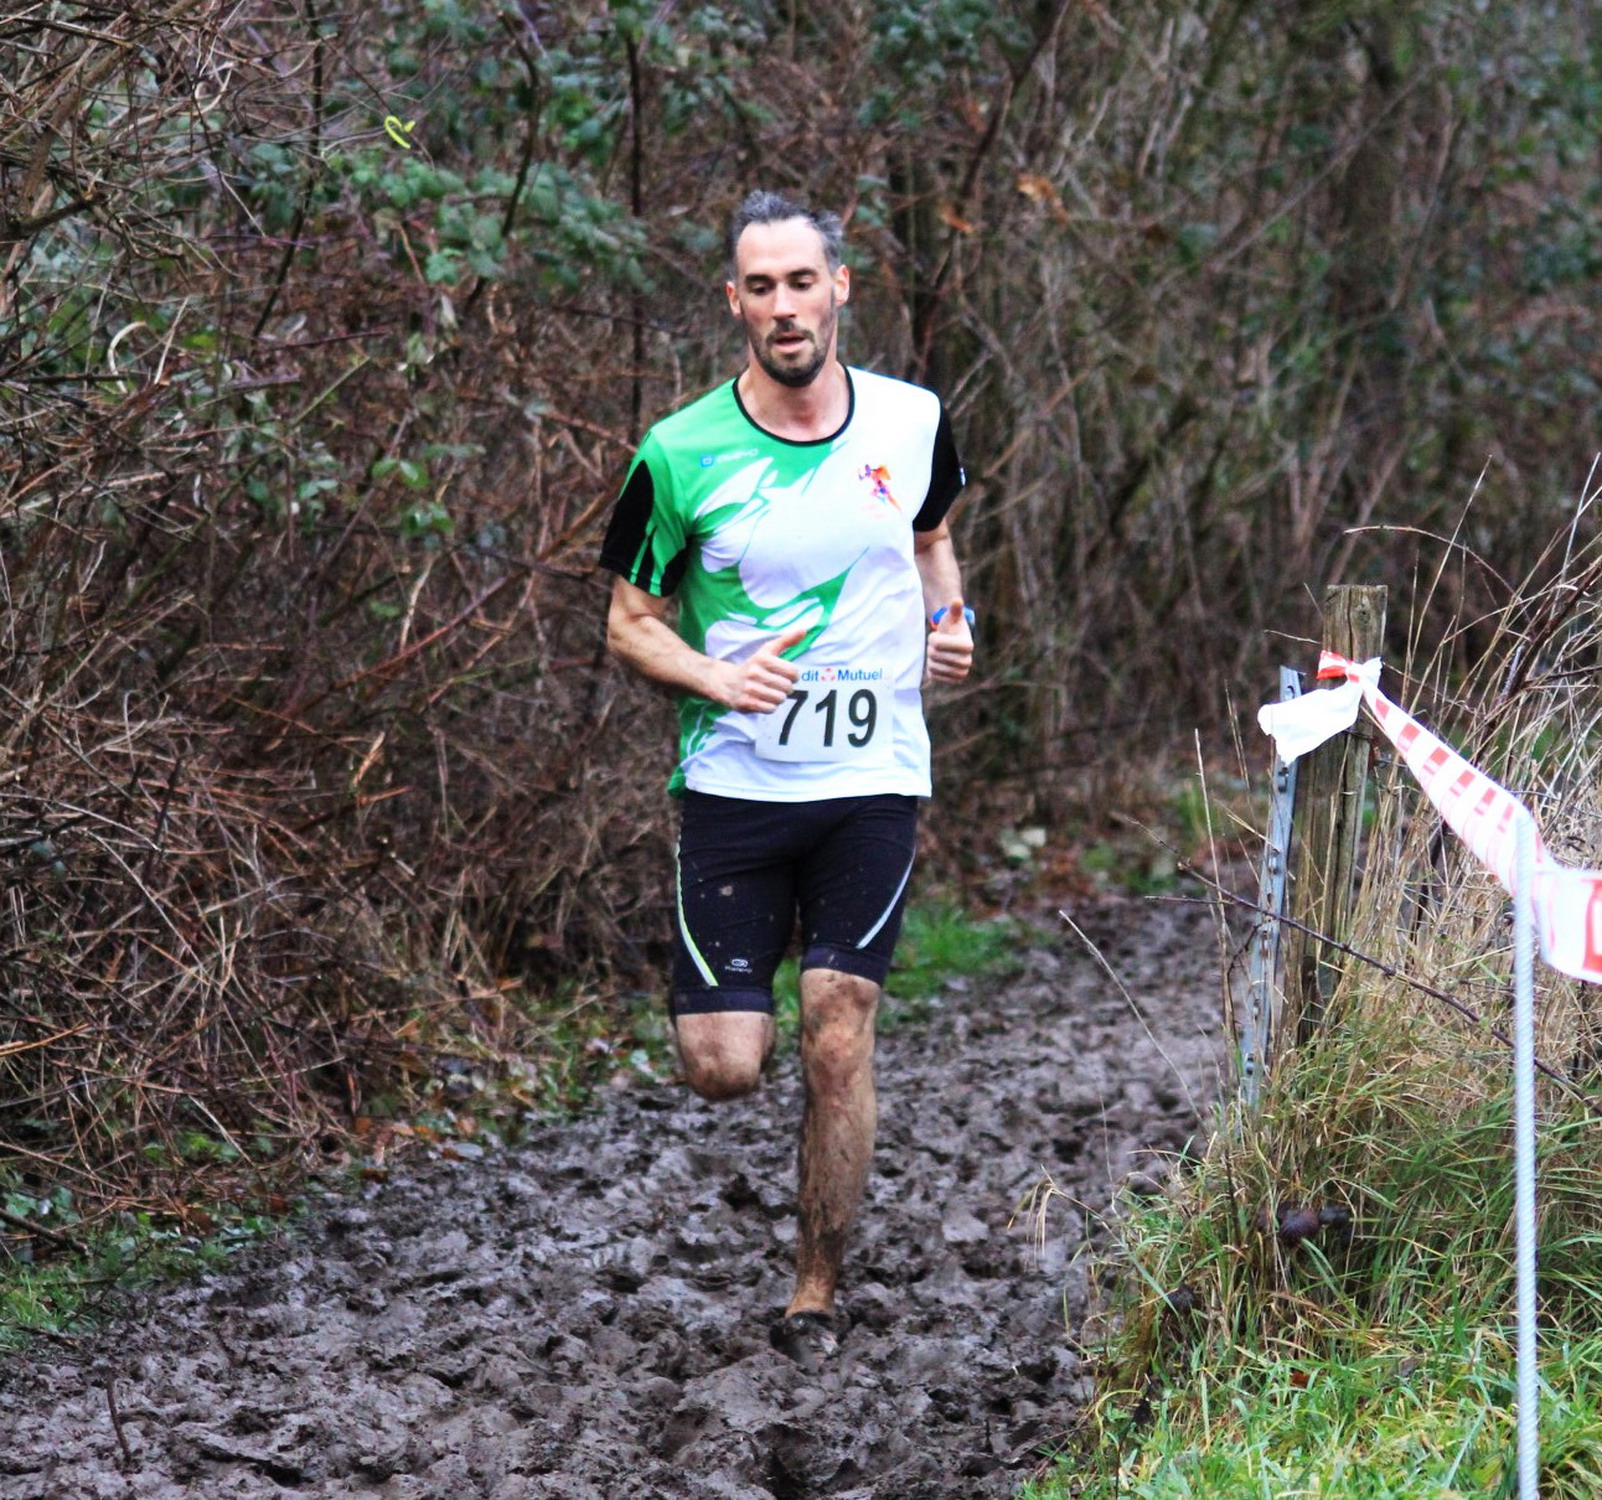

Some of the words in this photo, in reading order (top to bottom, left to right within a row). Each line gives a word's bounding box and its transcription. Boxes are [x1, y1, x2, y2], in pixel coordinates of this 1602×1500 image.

[801, 669, 819, 682] dit
[837, 667, 882, 681] Mutuel
[778, 689, 878, 748] 719
